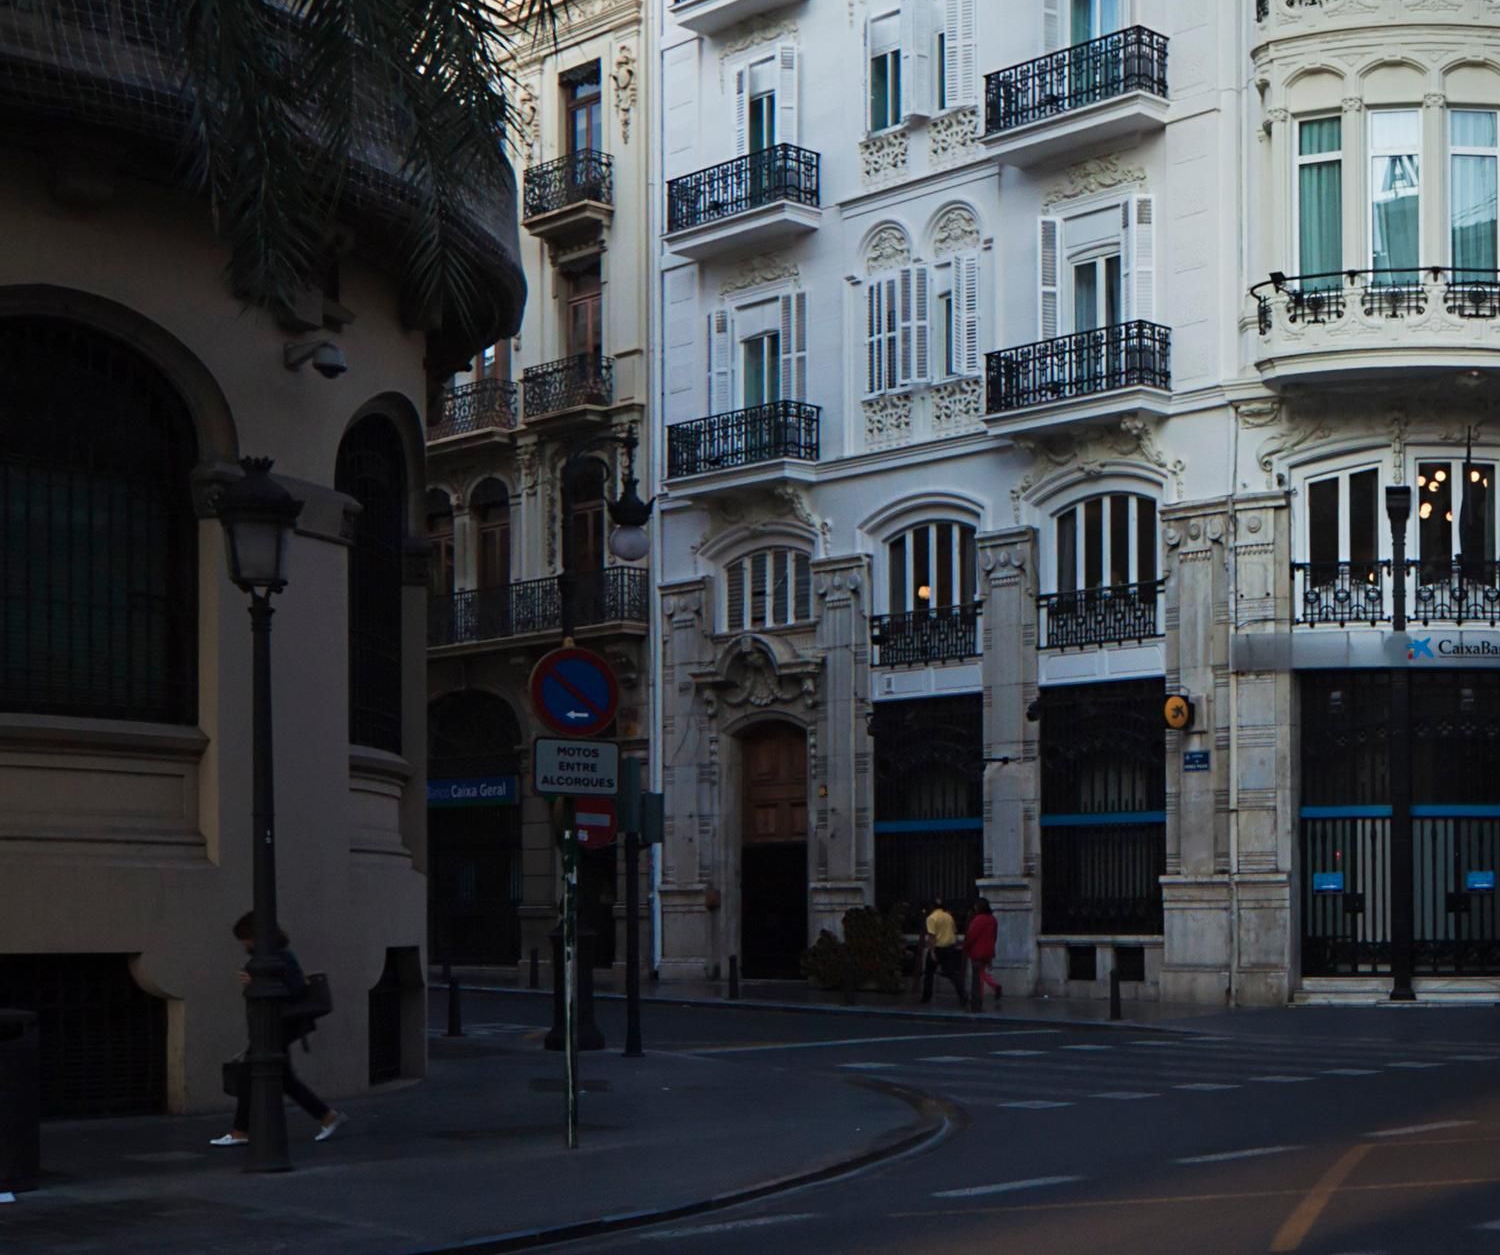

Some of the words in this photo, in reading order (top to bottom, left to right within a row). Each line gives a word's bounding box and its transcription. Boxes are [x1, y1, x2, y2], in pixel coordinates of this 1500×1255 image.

[557, 746, 600, 759] MOTOS
[558, 761, 598, 773] ENTRE
[541, 775, 615, 789] ALCORQUES
[451, 784, 478, 799] Caixa
[479, 781, 507, 798] Geral
